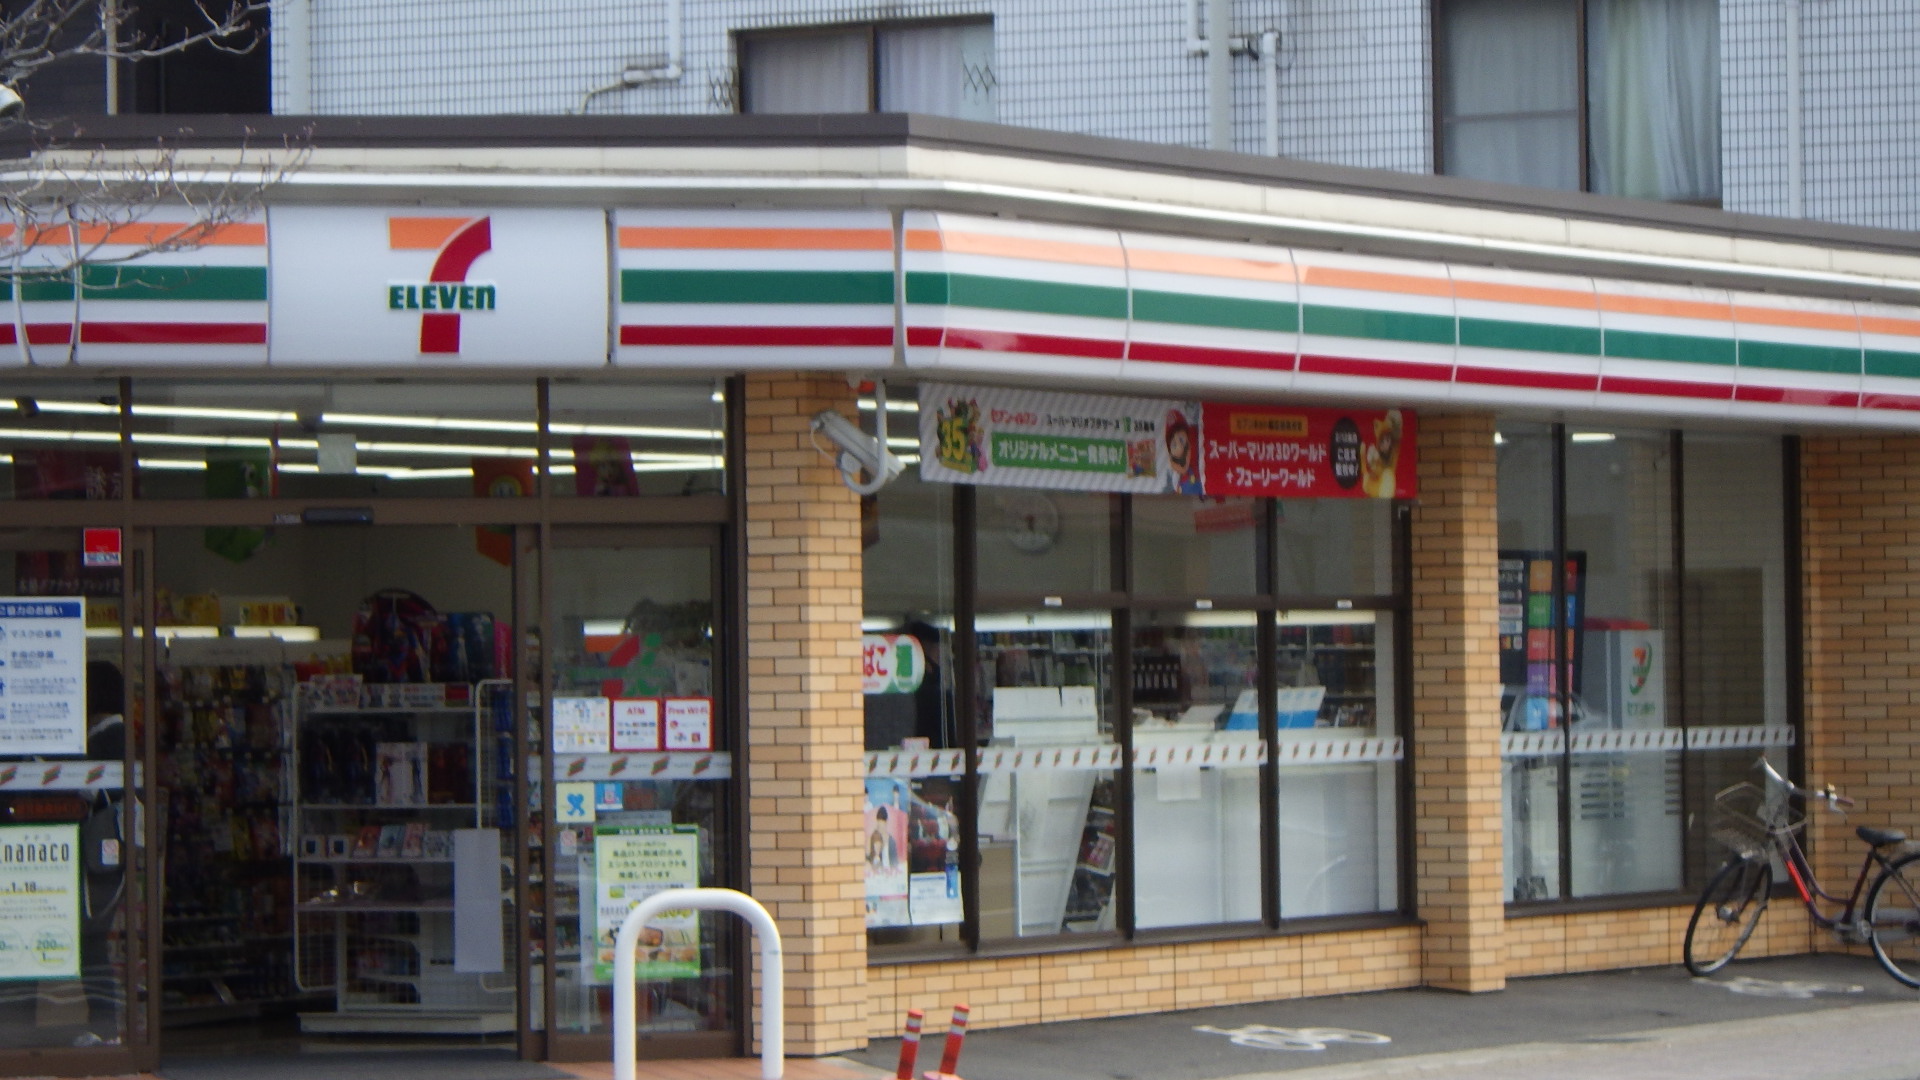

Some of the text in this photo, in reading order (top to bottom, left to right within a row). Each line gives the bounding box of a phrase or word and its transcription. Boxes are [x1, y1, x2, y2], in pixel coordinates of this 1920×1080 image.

[87, 553, 119, 562] SECOM
[627, 707, 646, 715] ATM
[668, 707, 685, 715] Free
[4, 842, 70, 863] nanaco
